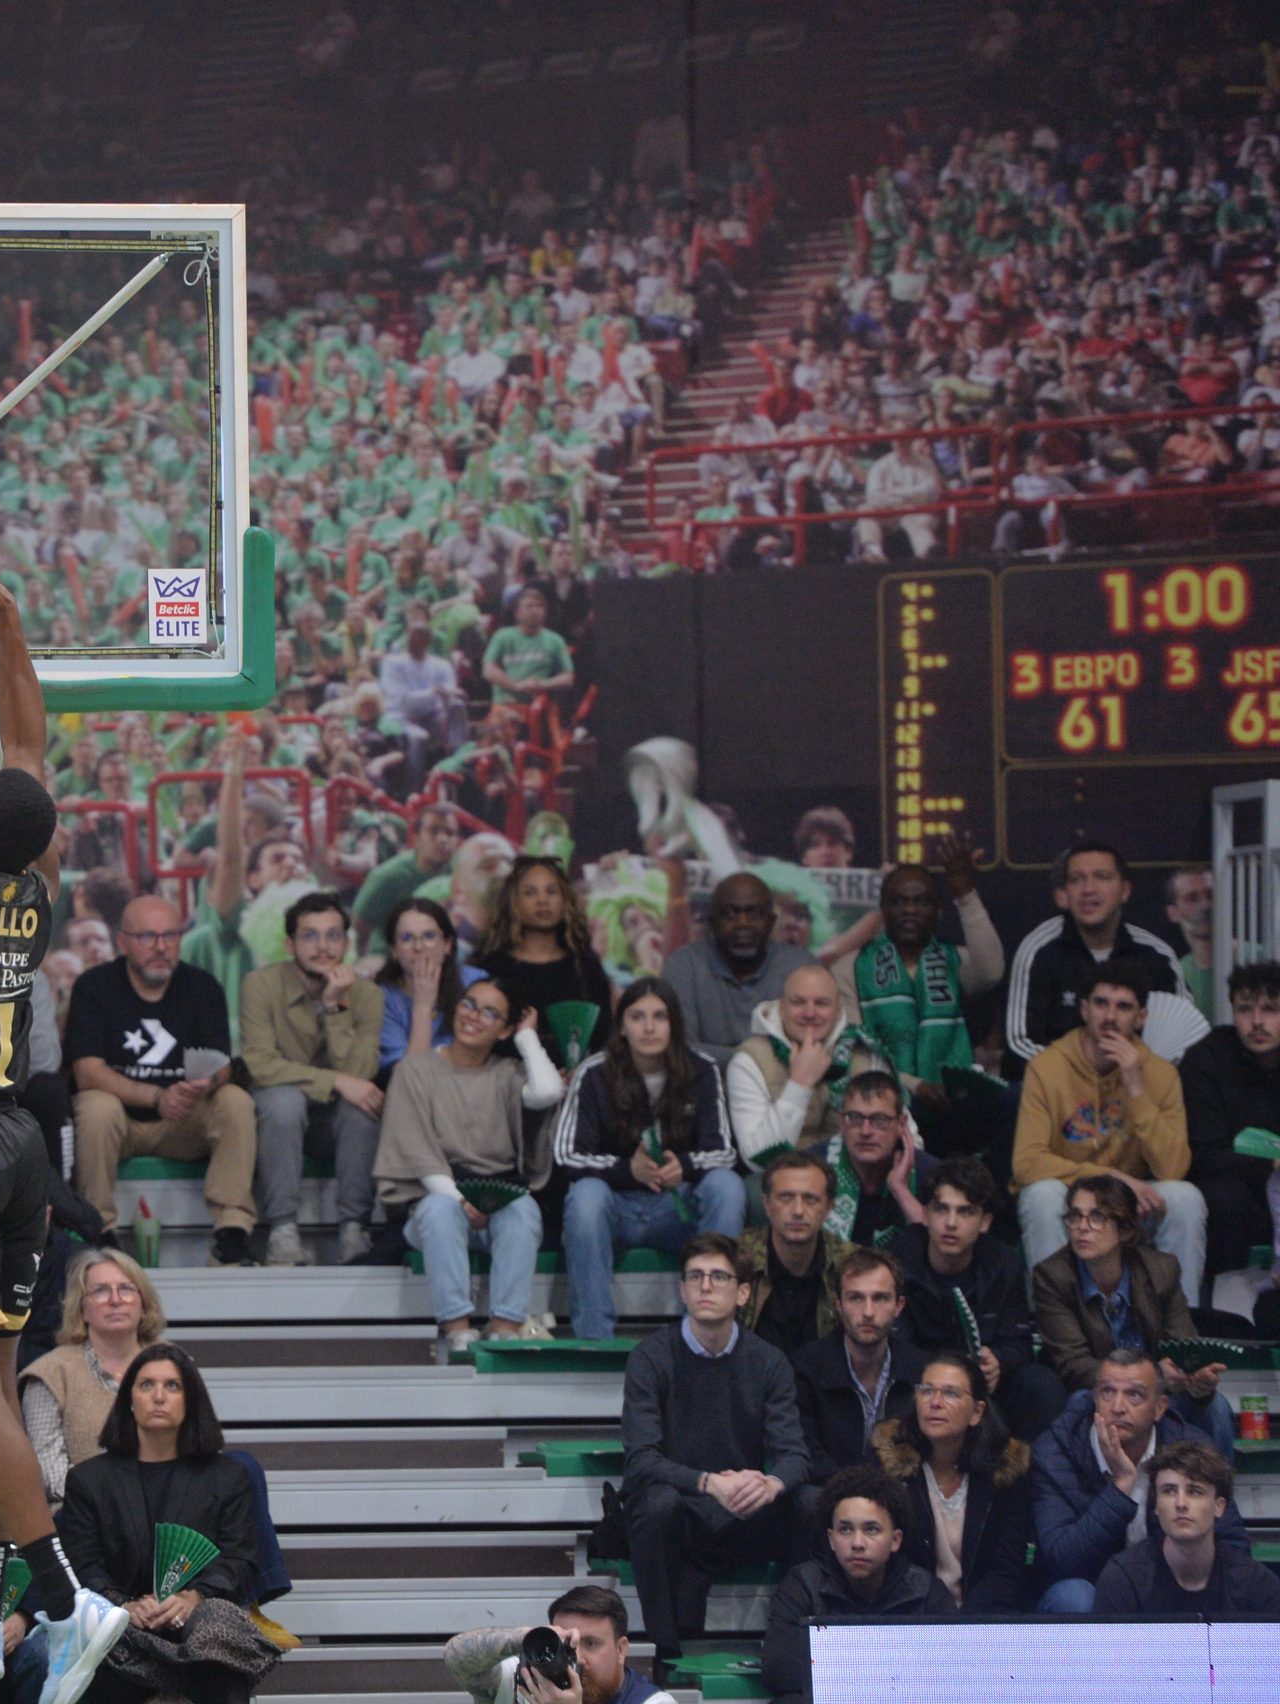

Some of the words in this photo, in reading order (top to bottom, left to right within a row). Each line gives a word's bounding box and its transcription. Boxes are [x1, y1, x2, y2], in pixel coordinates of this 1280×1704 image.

[158, 604, 196, 615] Betclic
[1105, 567, 1245, 632] 1:00
[156, 618, 201, 637] ÉLITE
[1014, 655, 1041, 694] 3
[1167, 647, 1195, 686] 3
[1059, 696, 1125, 749] 61
